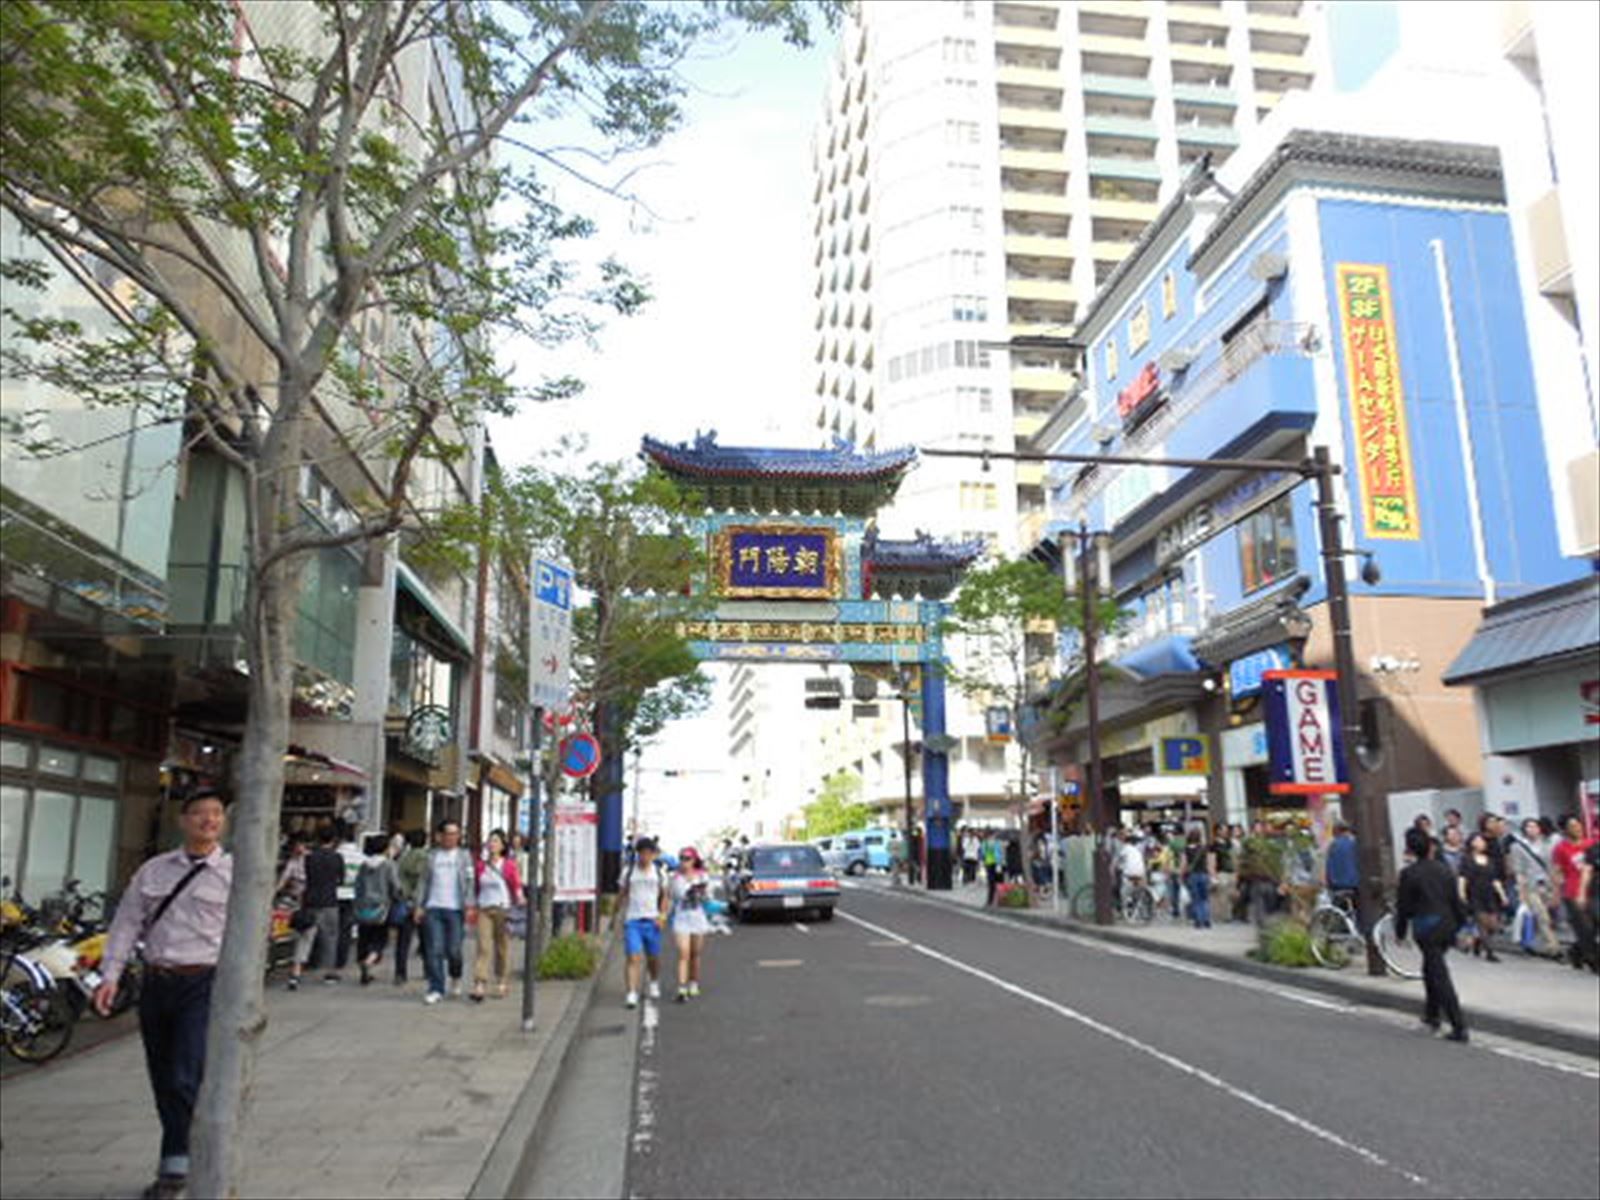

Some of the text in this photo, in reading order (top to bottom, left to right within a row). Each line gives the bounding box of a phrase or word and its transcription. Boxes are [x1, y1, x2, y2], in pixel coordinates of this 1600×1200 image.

[1350, 324, 1381, 488] ゲームセンター
[1165, 738, 1203, 770] P
[1296, 679, 1325, 782] GAME
